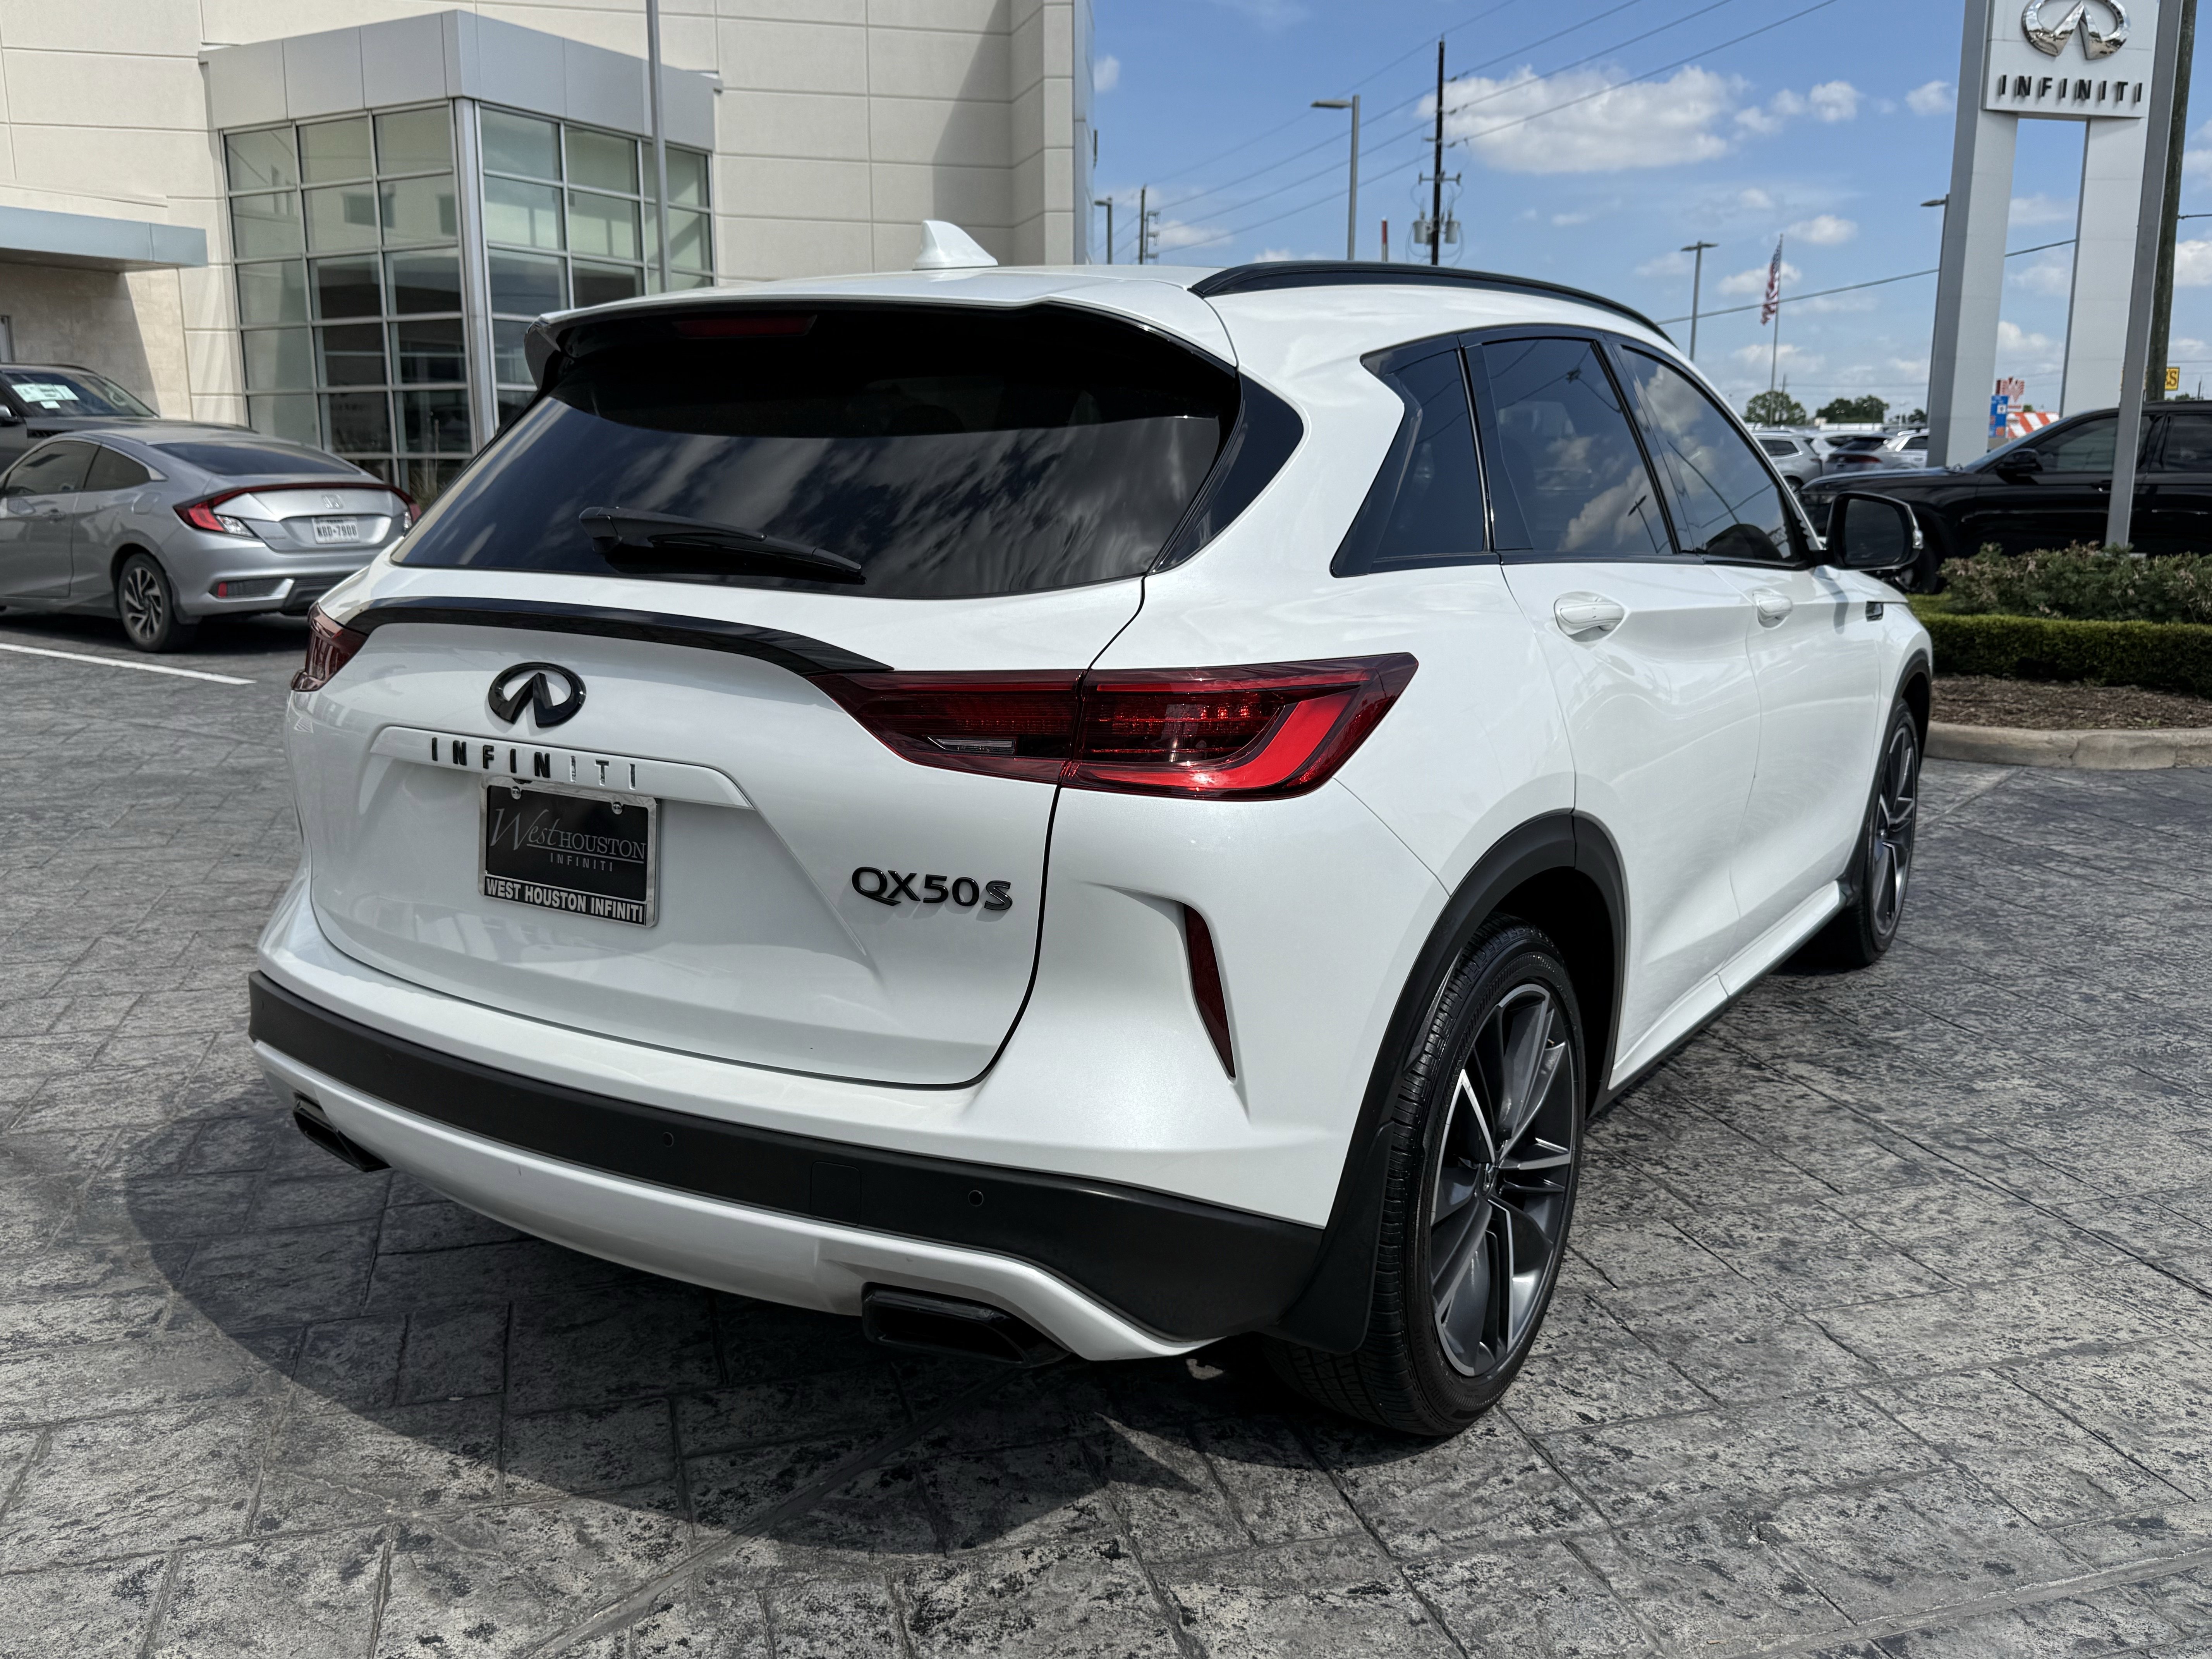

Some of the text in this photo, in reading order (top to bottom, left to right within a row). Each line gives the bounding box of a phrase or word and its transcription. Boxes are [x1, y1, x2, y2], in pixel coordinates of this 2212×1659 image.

[1999, 75, 2142, 102] INFINITI
[432, 737, 636, 790] INFINITI
[490, 808, 647, 860] West HOUSTON
[550, 853, 613, 872] INFINITI
[487, 878, 643, 922] WEST HOUSTON INFINITI
